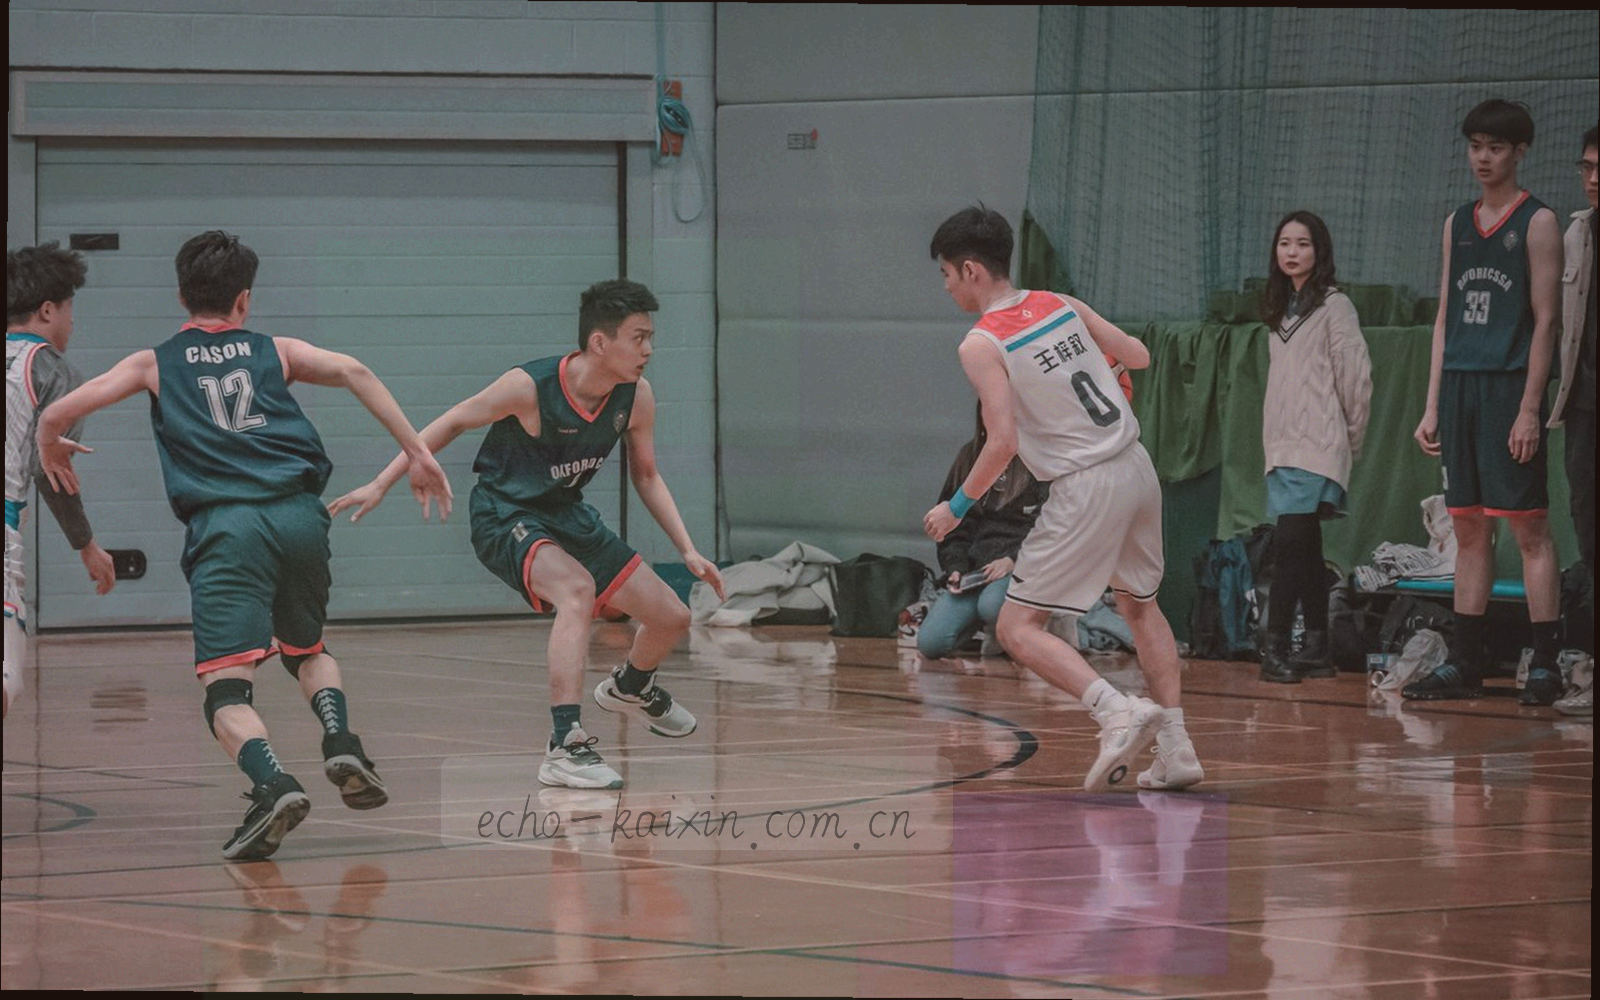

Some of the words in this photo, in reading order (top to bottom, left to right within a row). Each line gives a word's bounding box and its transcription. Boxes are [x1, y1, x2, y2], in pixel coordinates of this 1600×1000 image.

[1463, 290, 1491, 325] 33
[185, 342, 252, 364] CASON
[197, 368, 267, 432] 12
[1071, 370, 1122, 427] 0
